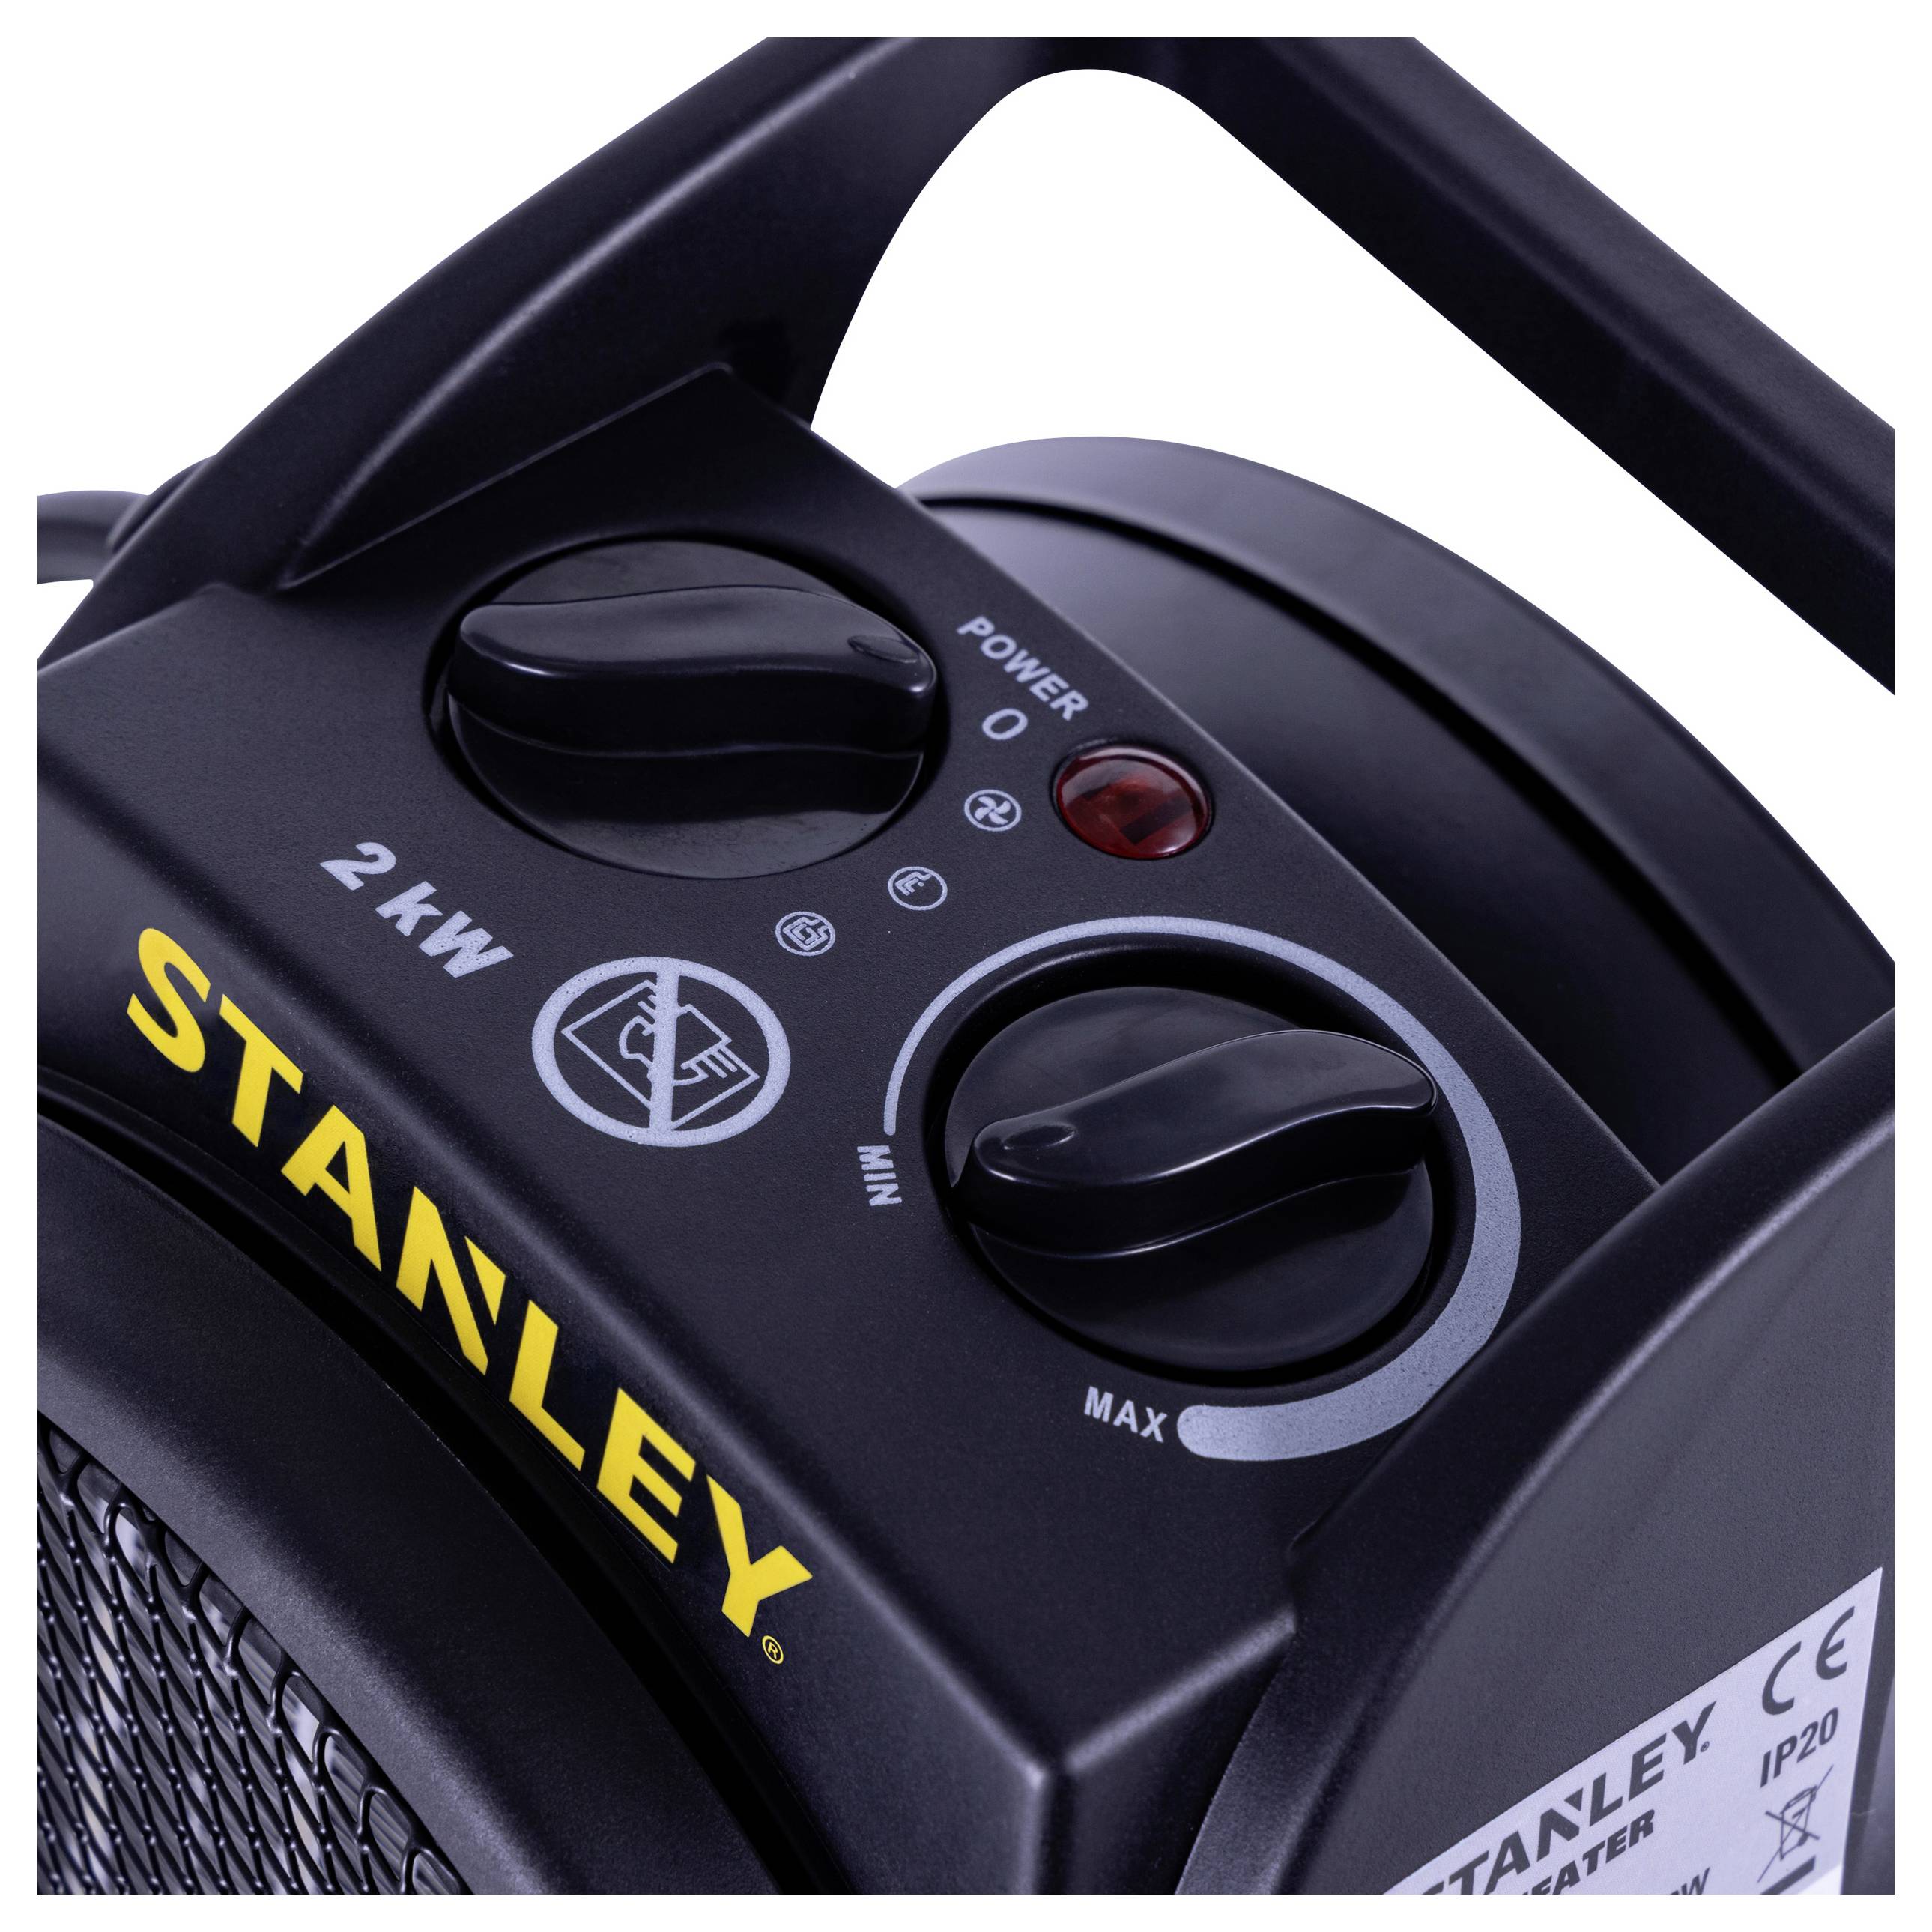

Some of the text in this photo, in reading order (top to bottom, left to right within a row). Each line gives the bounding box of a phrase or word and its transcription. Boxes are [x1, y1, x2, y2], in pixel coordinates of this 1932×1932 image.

[957, 616, 1088, 721] POWER
[320, 841, 514, 978] 2 kW
[856, 1145, 903, 1206] MIN
[127, 927, 812, 1638] STANLEY
[1084, 1386, 1167, 1443] MAX
[1762, 1606, 1855, 1716] CE
[1422, 1701, 1717, 1895] TANLEY
[1760, 1707, 1839, 1789] IP20
[1521, 1809, 1656, 1895] EATER
